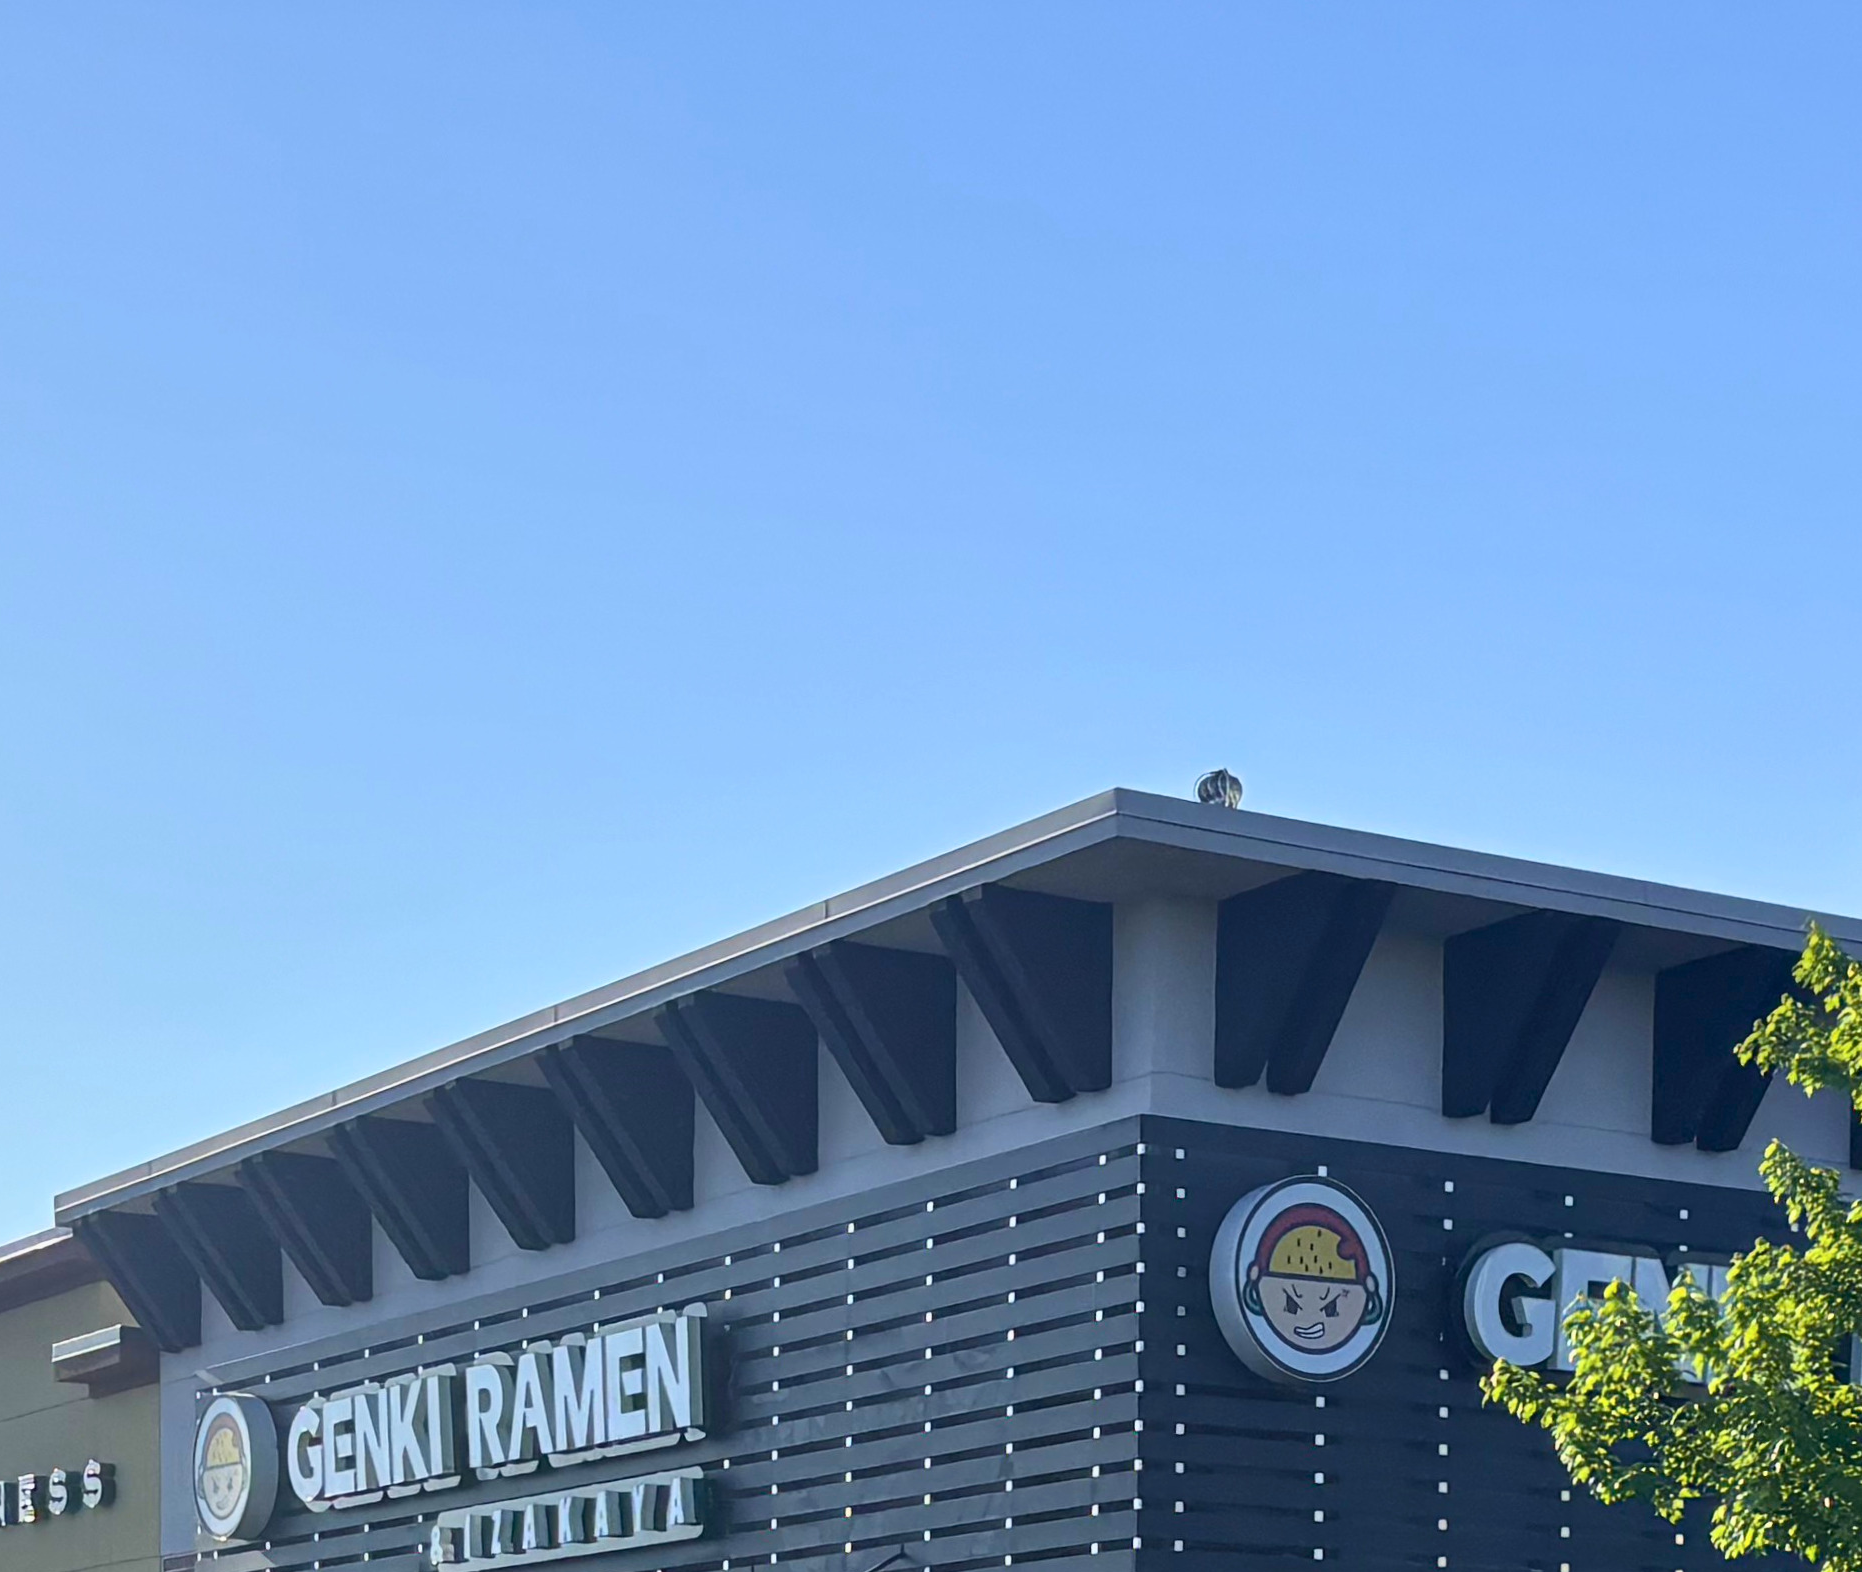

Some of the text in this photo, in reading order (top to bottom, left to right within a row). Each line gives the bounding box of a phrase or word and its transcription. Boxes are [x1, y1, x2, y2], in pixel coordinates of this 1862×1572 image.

[1464, 1241, 1762, 1386] GEN
[287, 1315, 701, 1503] GENKI RAMEN
[464, 1477, 693, 1557] IZAKAYA
